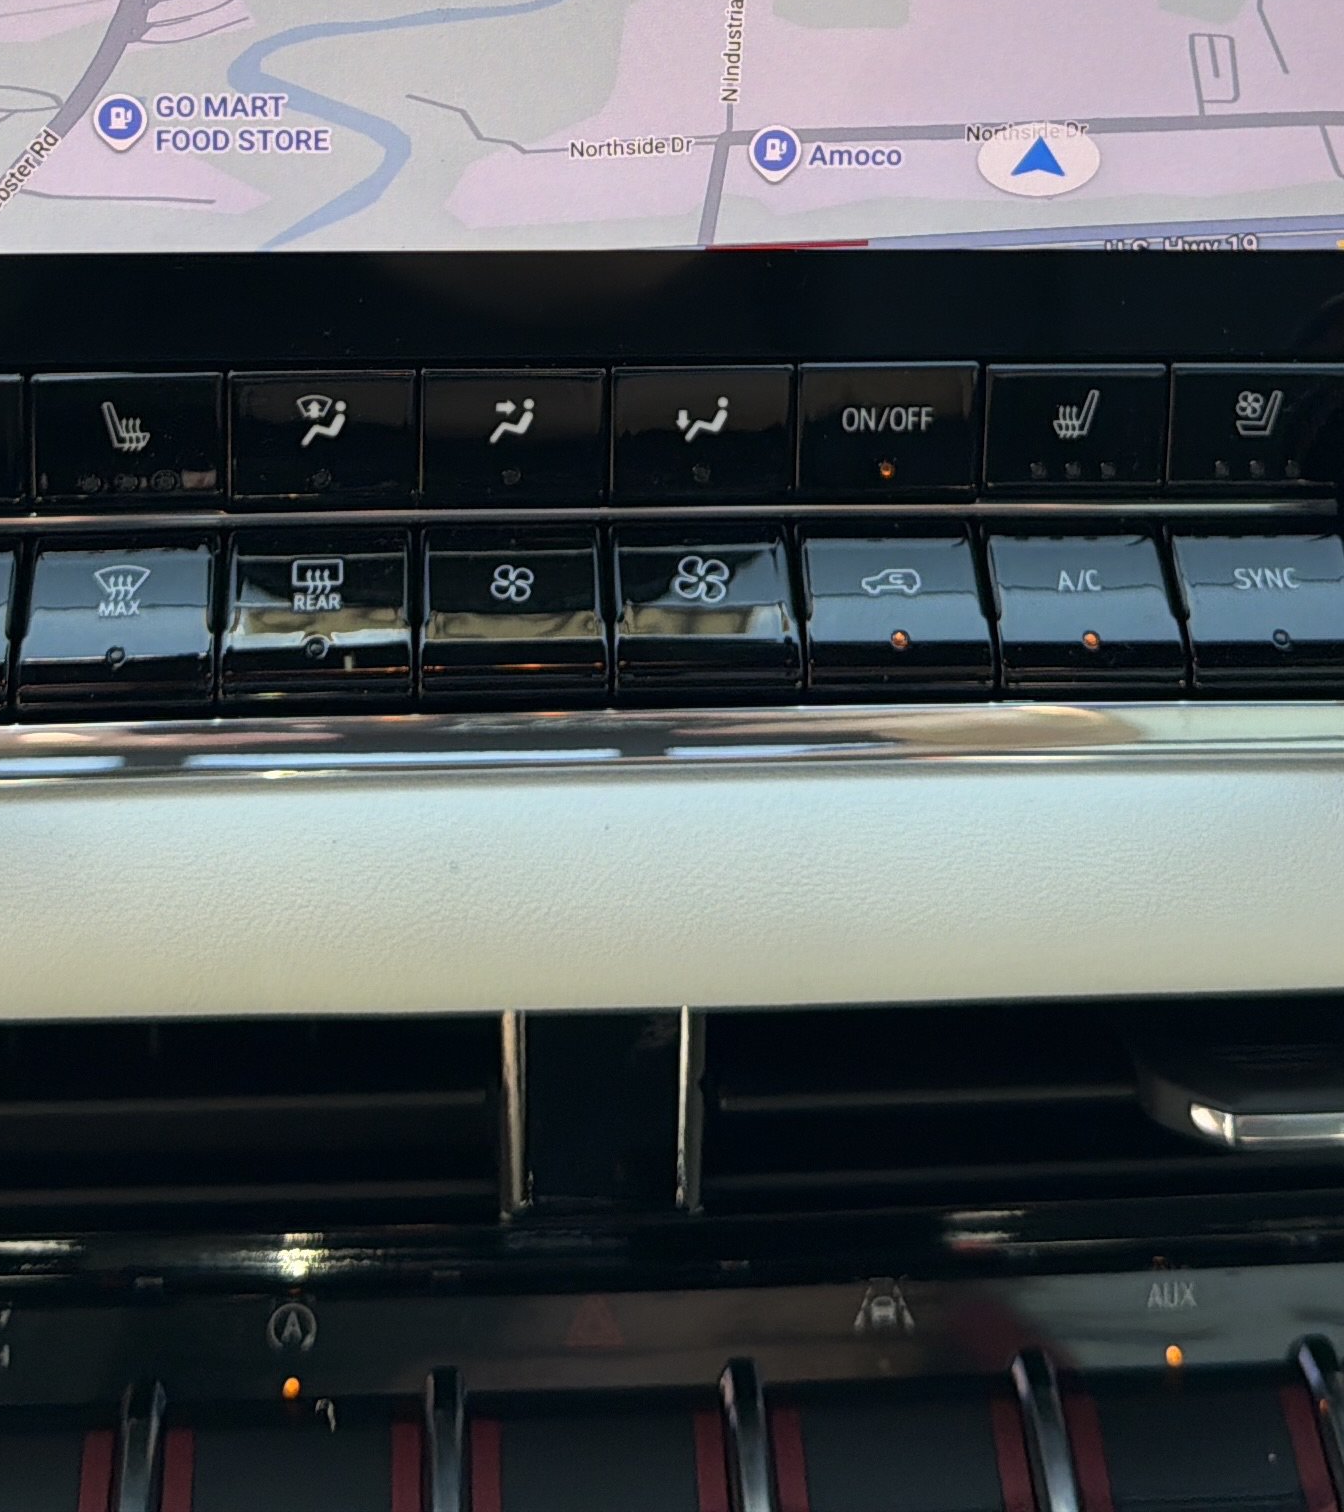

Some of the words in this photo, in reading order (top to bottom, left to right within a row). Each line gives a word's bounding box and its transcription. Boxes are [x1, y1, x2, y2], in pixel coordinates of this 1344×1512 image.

[156, 95, 195, 117] GO
[204, 95, 286, 117] MART
[721, 88, 738, 103] N
[29, 128, 59, 159] Rd
[156, 129, 230, 151] FOOD
[238, 129, 329, 151] STORE
[570, 139, 666, 159] Northside
[671, 137, 693, 154] Dr
[808, 144, 903, 167] Amoco
[841, 405, 934, 433] ON/OFF
[1057, 568, 1101, 594] A/C
[1233, 566, 1298, 591] SYNC
[98, 598, 141, 617] MAX
[292, 592, 342, 611] REAR
[1147, 1282, 1198, 1308] AUX
